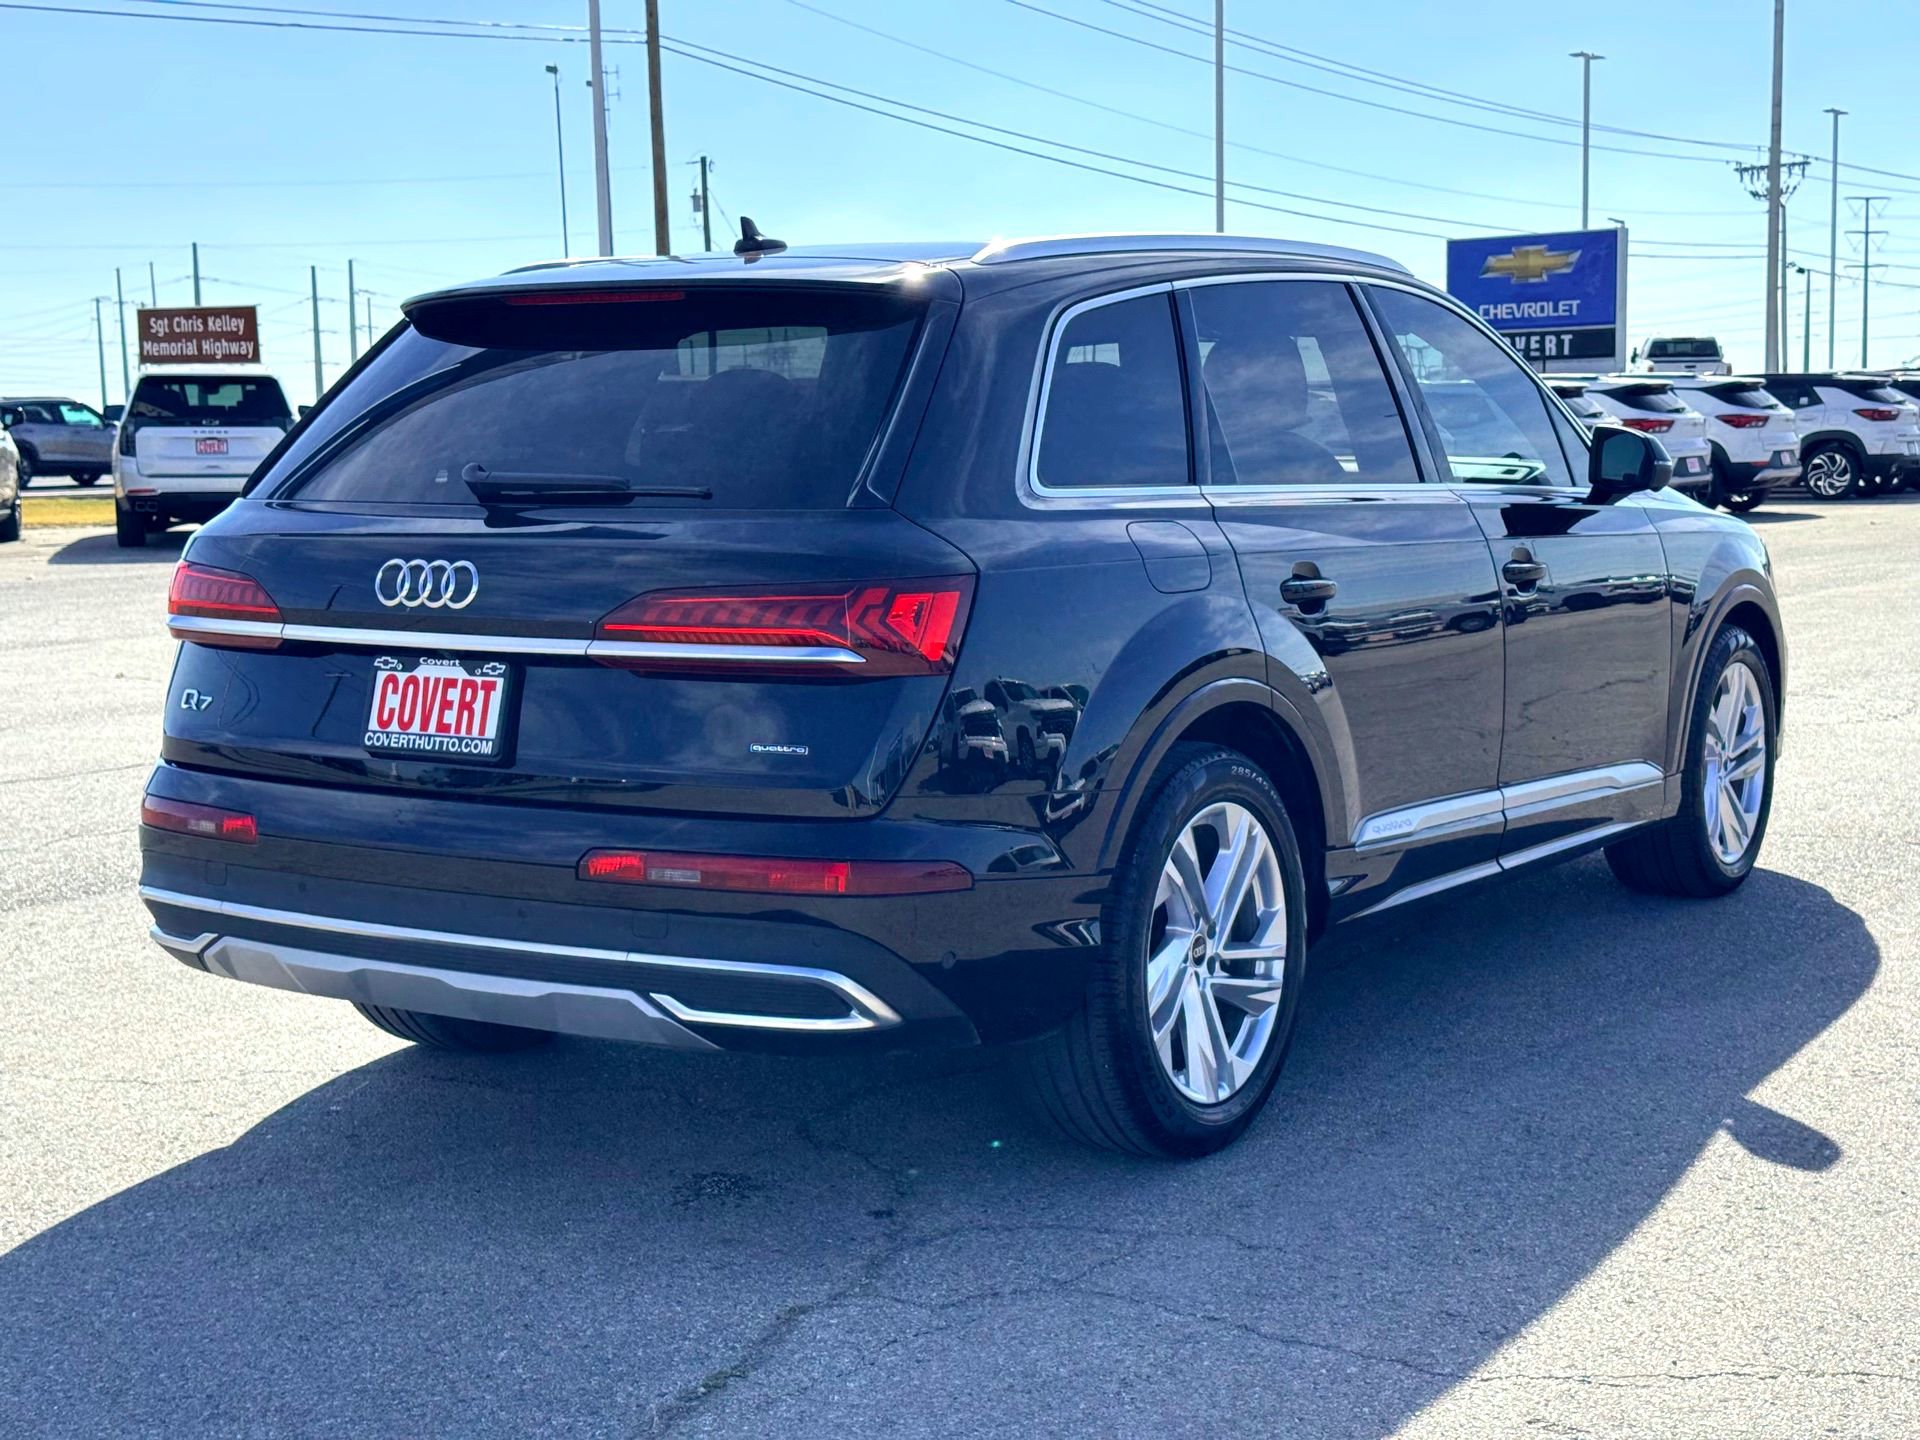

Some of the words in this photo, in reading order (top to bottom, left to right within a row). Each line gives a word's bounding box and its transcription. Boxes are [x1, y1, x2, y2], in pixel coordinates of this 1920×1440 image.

[1479, 300, 1581, 320] CHEVROLET
[149, 317, 169, 337] Sgt
[172, 315, 204, 333] Chris
[207, 314, 245, 335] Kelley
[142, 339, 198, 356] Memorial
[201, 338, 254, 359] Highway
[1502, 333, 1573, 357] VERT
[419, 656, 461, 667] Covert
[180, 688, 213, 711] Q7
[376, 673, 497, 737] COVERT
[364, 731, 493, 755] COVERTHUTTO.COM
[752, 744, 806, 754] quattro
